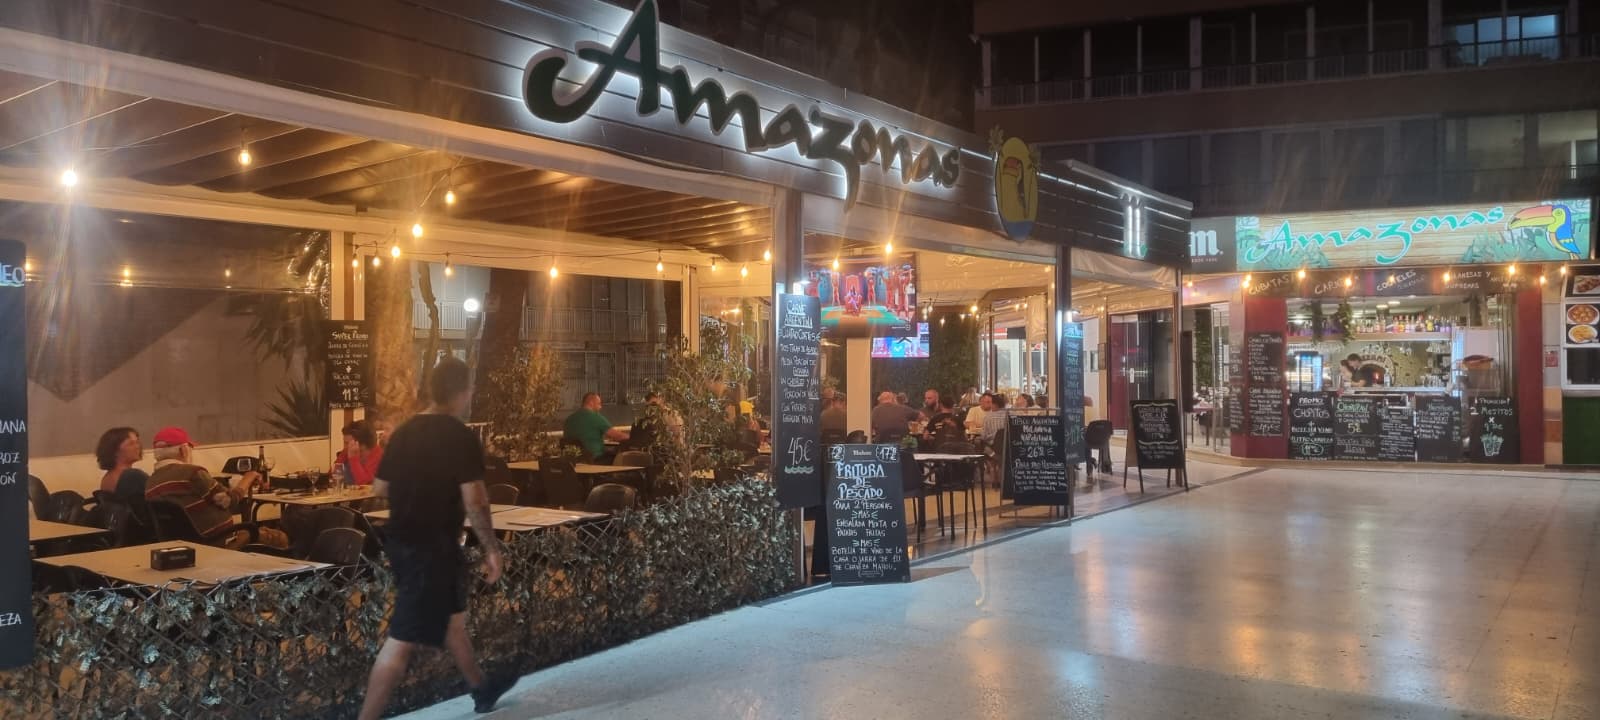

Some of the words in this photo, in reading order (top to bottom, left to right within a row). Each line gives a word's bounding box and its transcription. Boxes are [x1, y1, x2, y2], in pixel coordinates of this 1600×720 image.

[522, 0, 960, 213] Amazonas
[1245, 204, 1505, 266] Amazonas
[0, 263, 25, 284] EO
[787, 300, 807, 314] CARNE
[1470, 406, 1479, 416] 2
[0, 419, 26, 435] ANA
[787, 436, 813, 466] 45€
[835, 460, 885, 477] FRITURA
[837, 482, 884, 499] PESCADO
[853, 477, 872, 488] DE
[833, 500, 851, 510] PARA
[854, 500, 860, 509] 2
[860, 499, 893, 510] PERSONAS
[836, 519, 866, 528] ENSALADA
